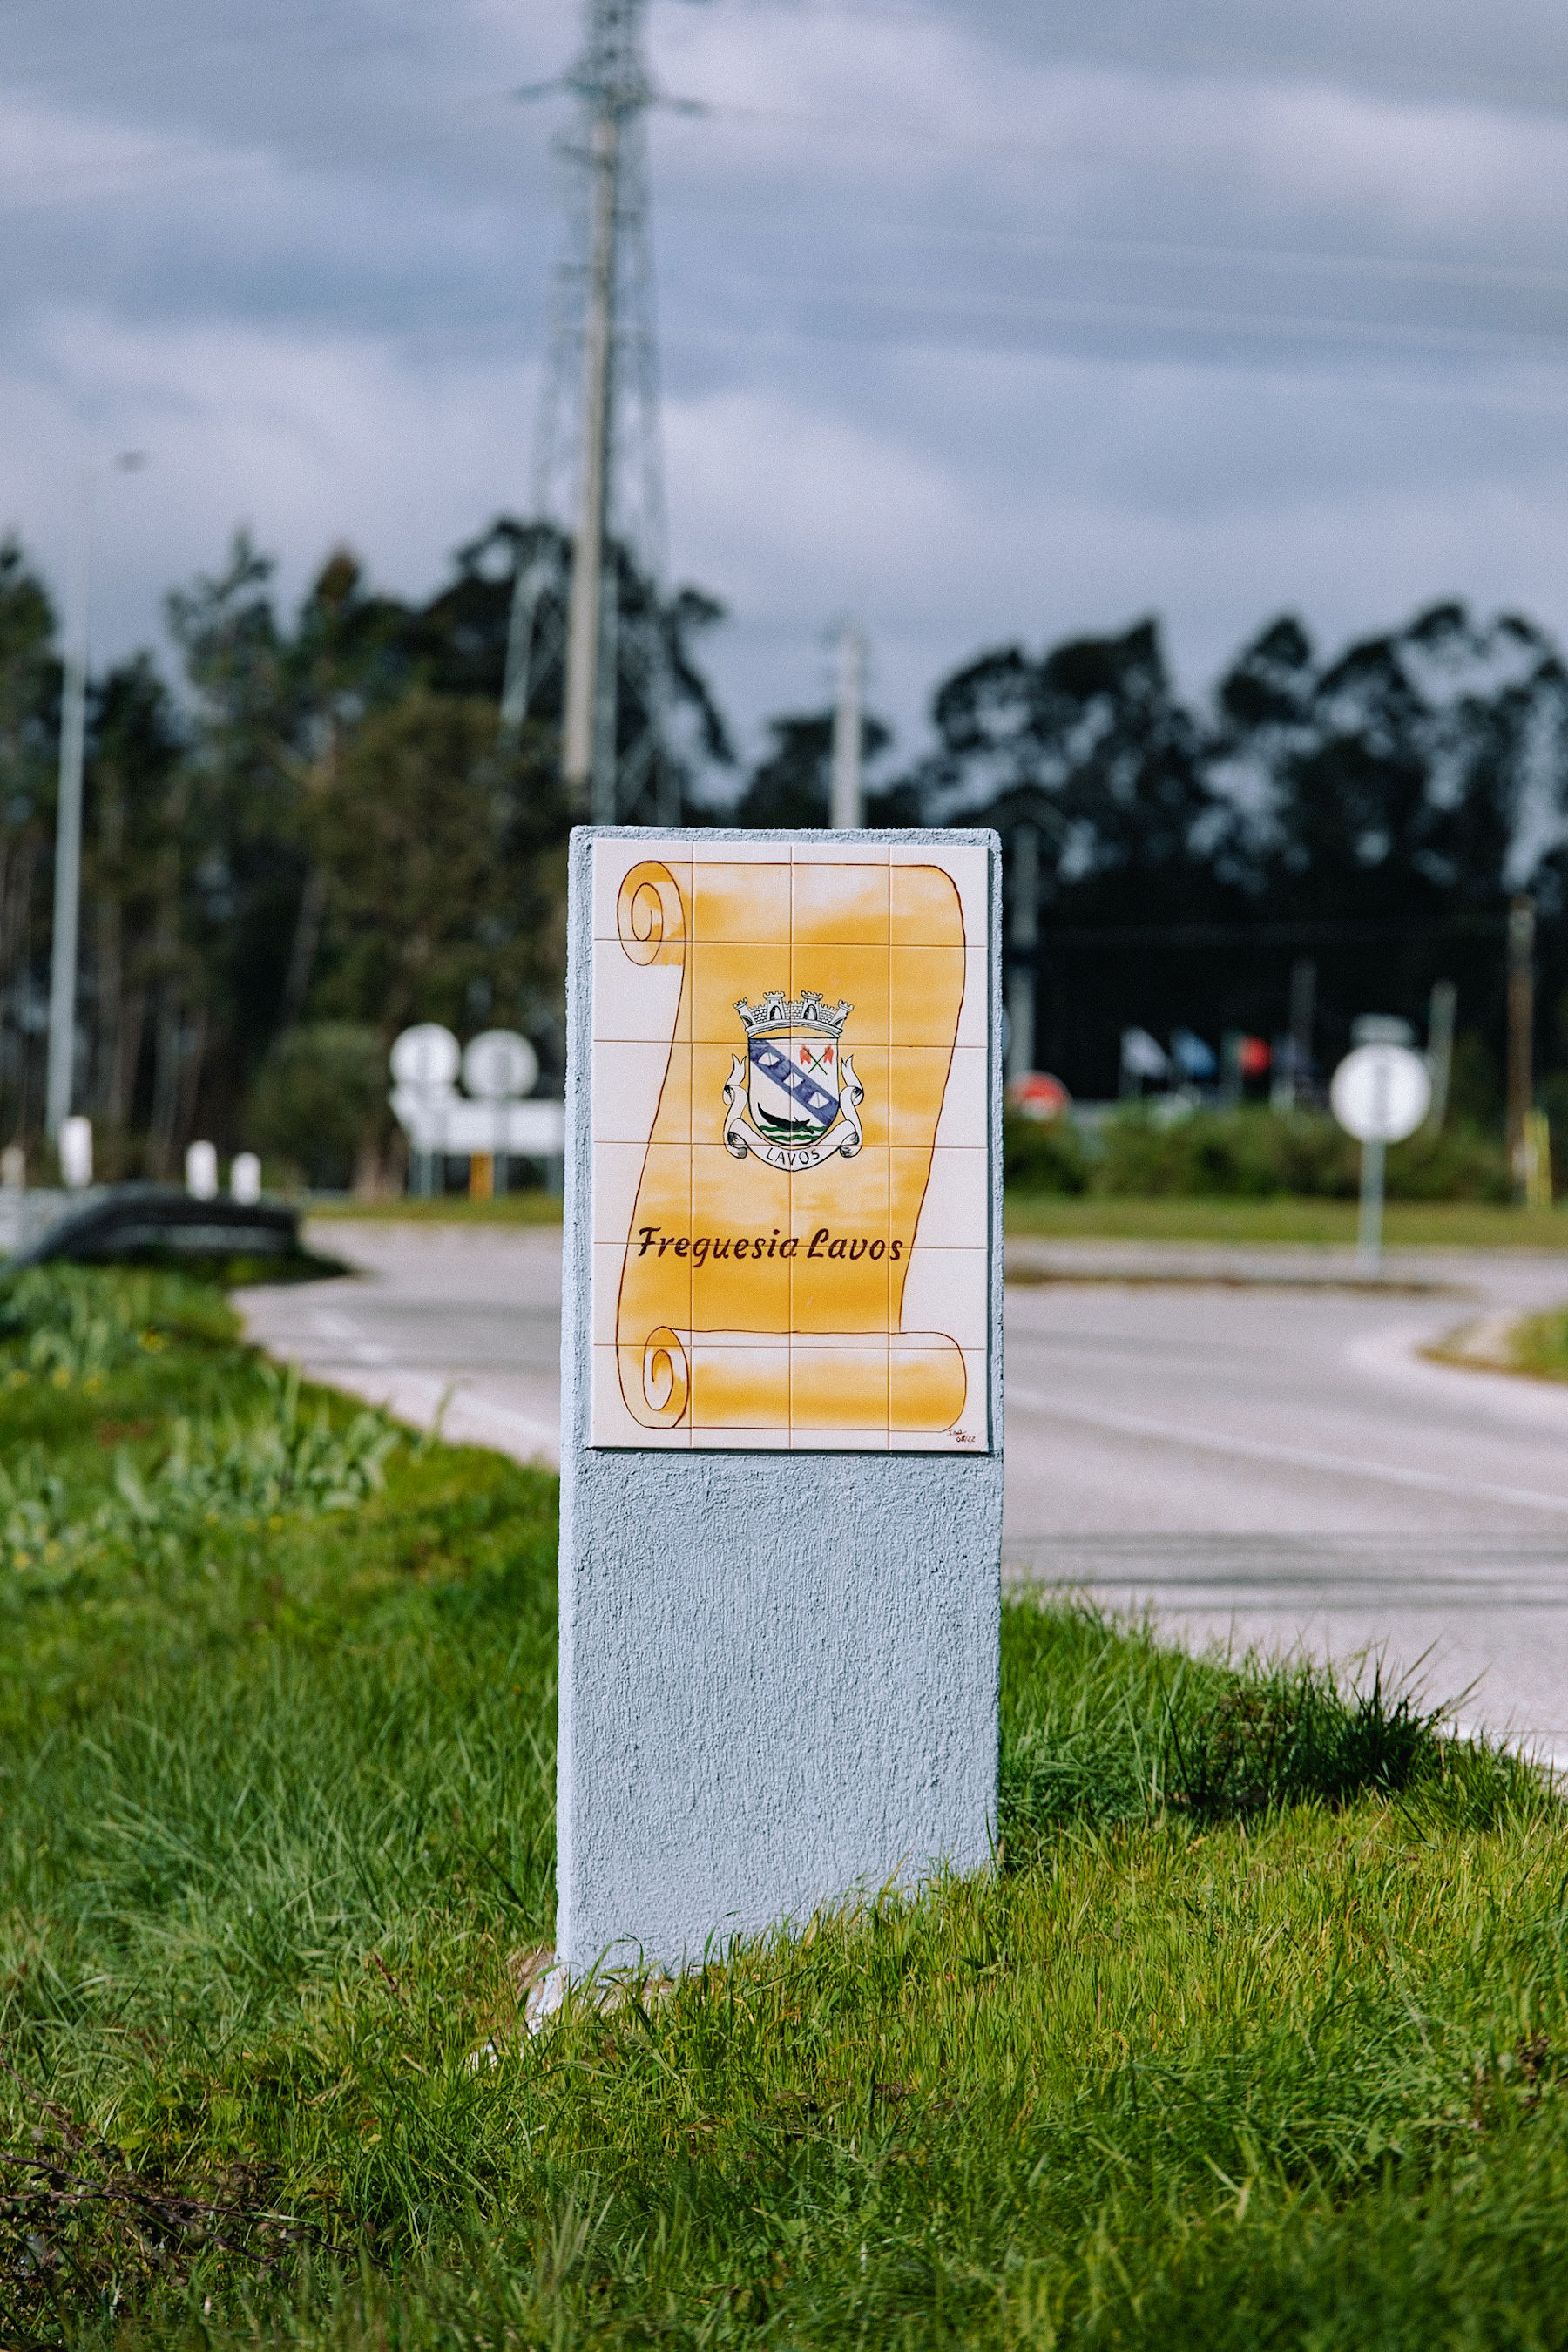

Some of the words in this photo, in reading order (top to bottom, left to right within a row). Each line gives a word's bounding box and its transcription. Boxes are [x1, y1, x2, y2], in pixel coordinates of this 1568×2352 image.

[766, 1147, 820, 1166] LAVOS
[638, 1227, 800, 1268] Freguesia
[807, 1228, 903, 1261] Lavos
